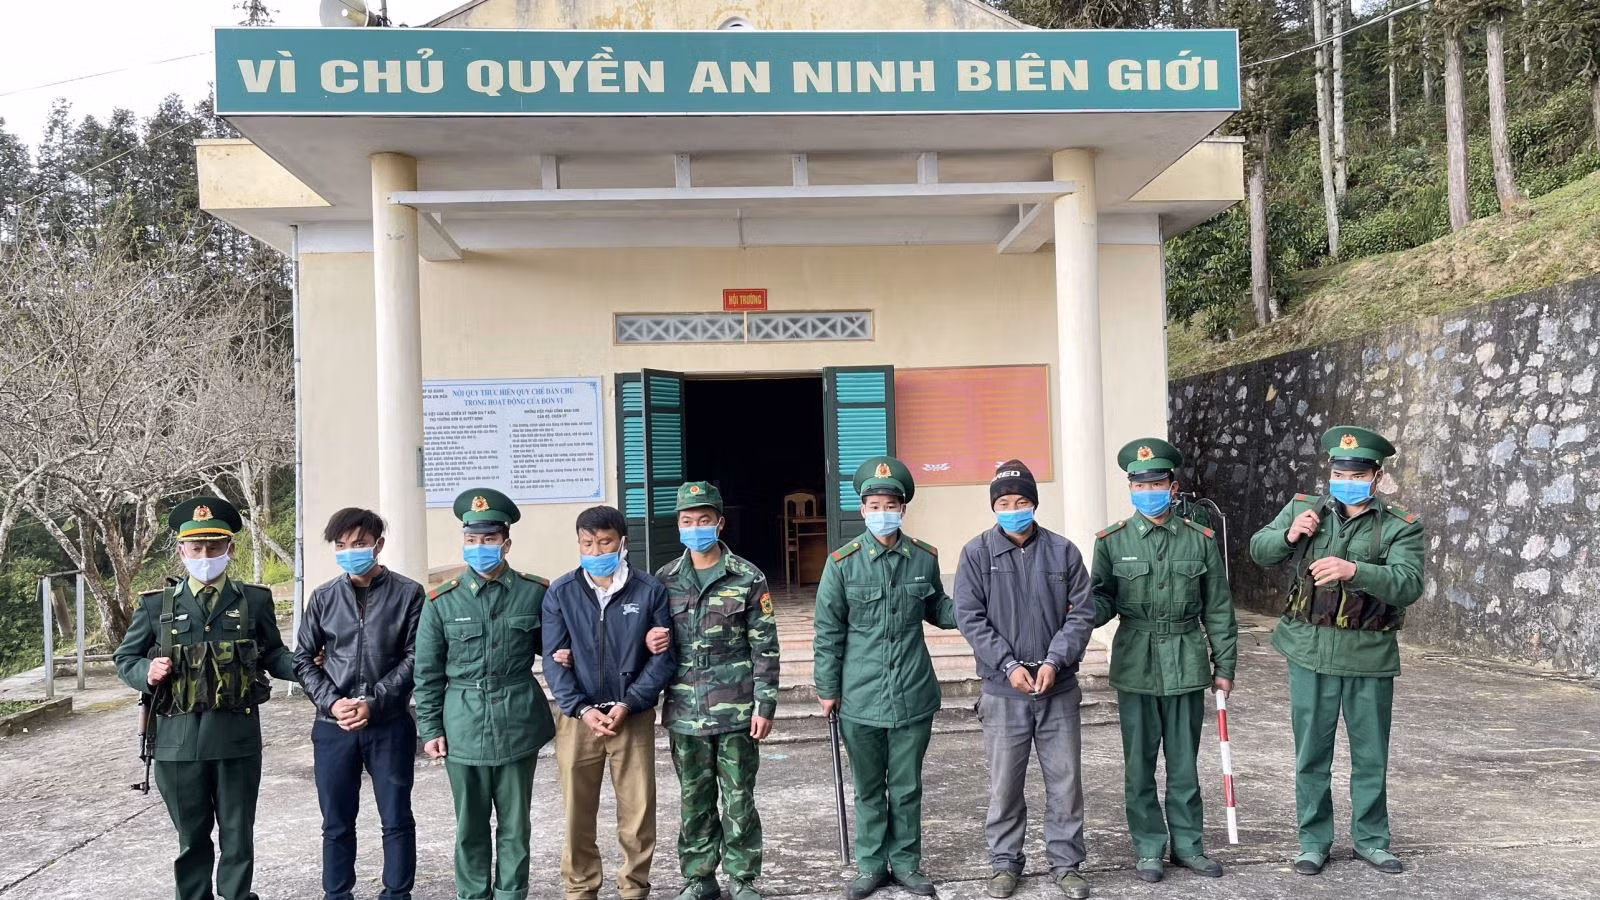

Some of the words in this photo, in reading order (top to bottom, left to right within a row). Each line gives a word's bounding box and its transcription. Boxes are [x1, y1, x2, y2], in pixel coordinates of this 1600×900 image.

[237, 50, 296, 94] VÌ
[320, 47, 444, 95] CHỦ
[466, 46, 665, 97] QUYỀN
[688, 60, 770, 94] AN
[793, 60, 936, 93] NINH
[957, 52, 1089, 92] BIÊN
[1107, 50, 1218, 92] GIỚI
[728, 293, 739, 307] HỘI
